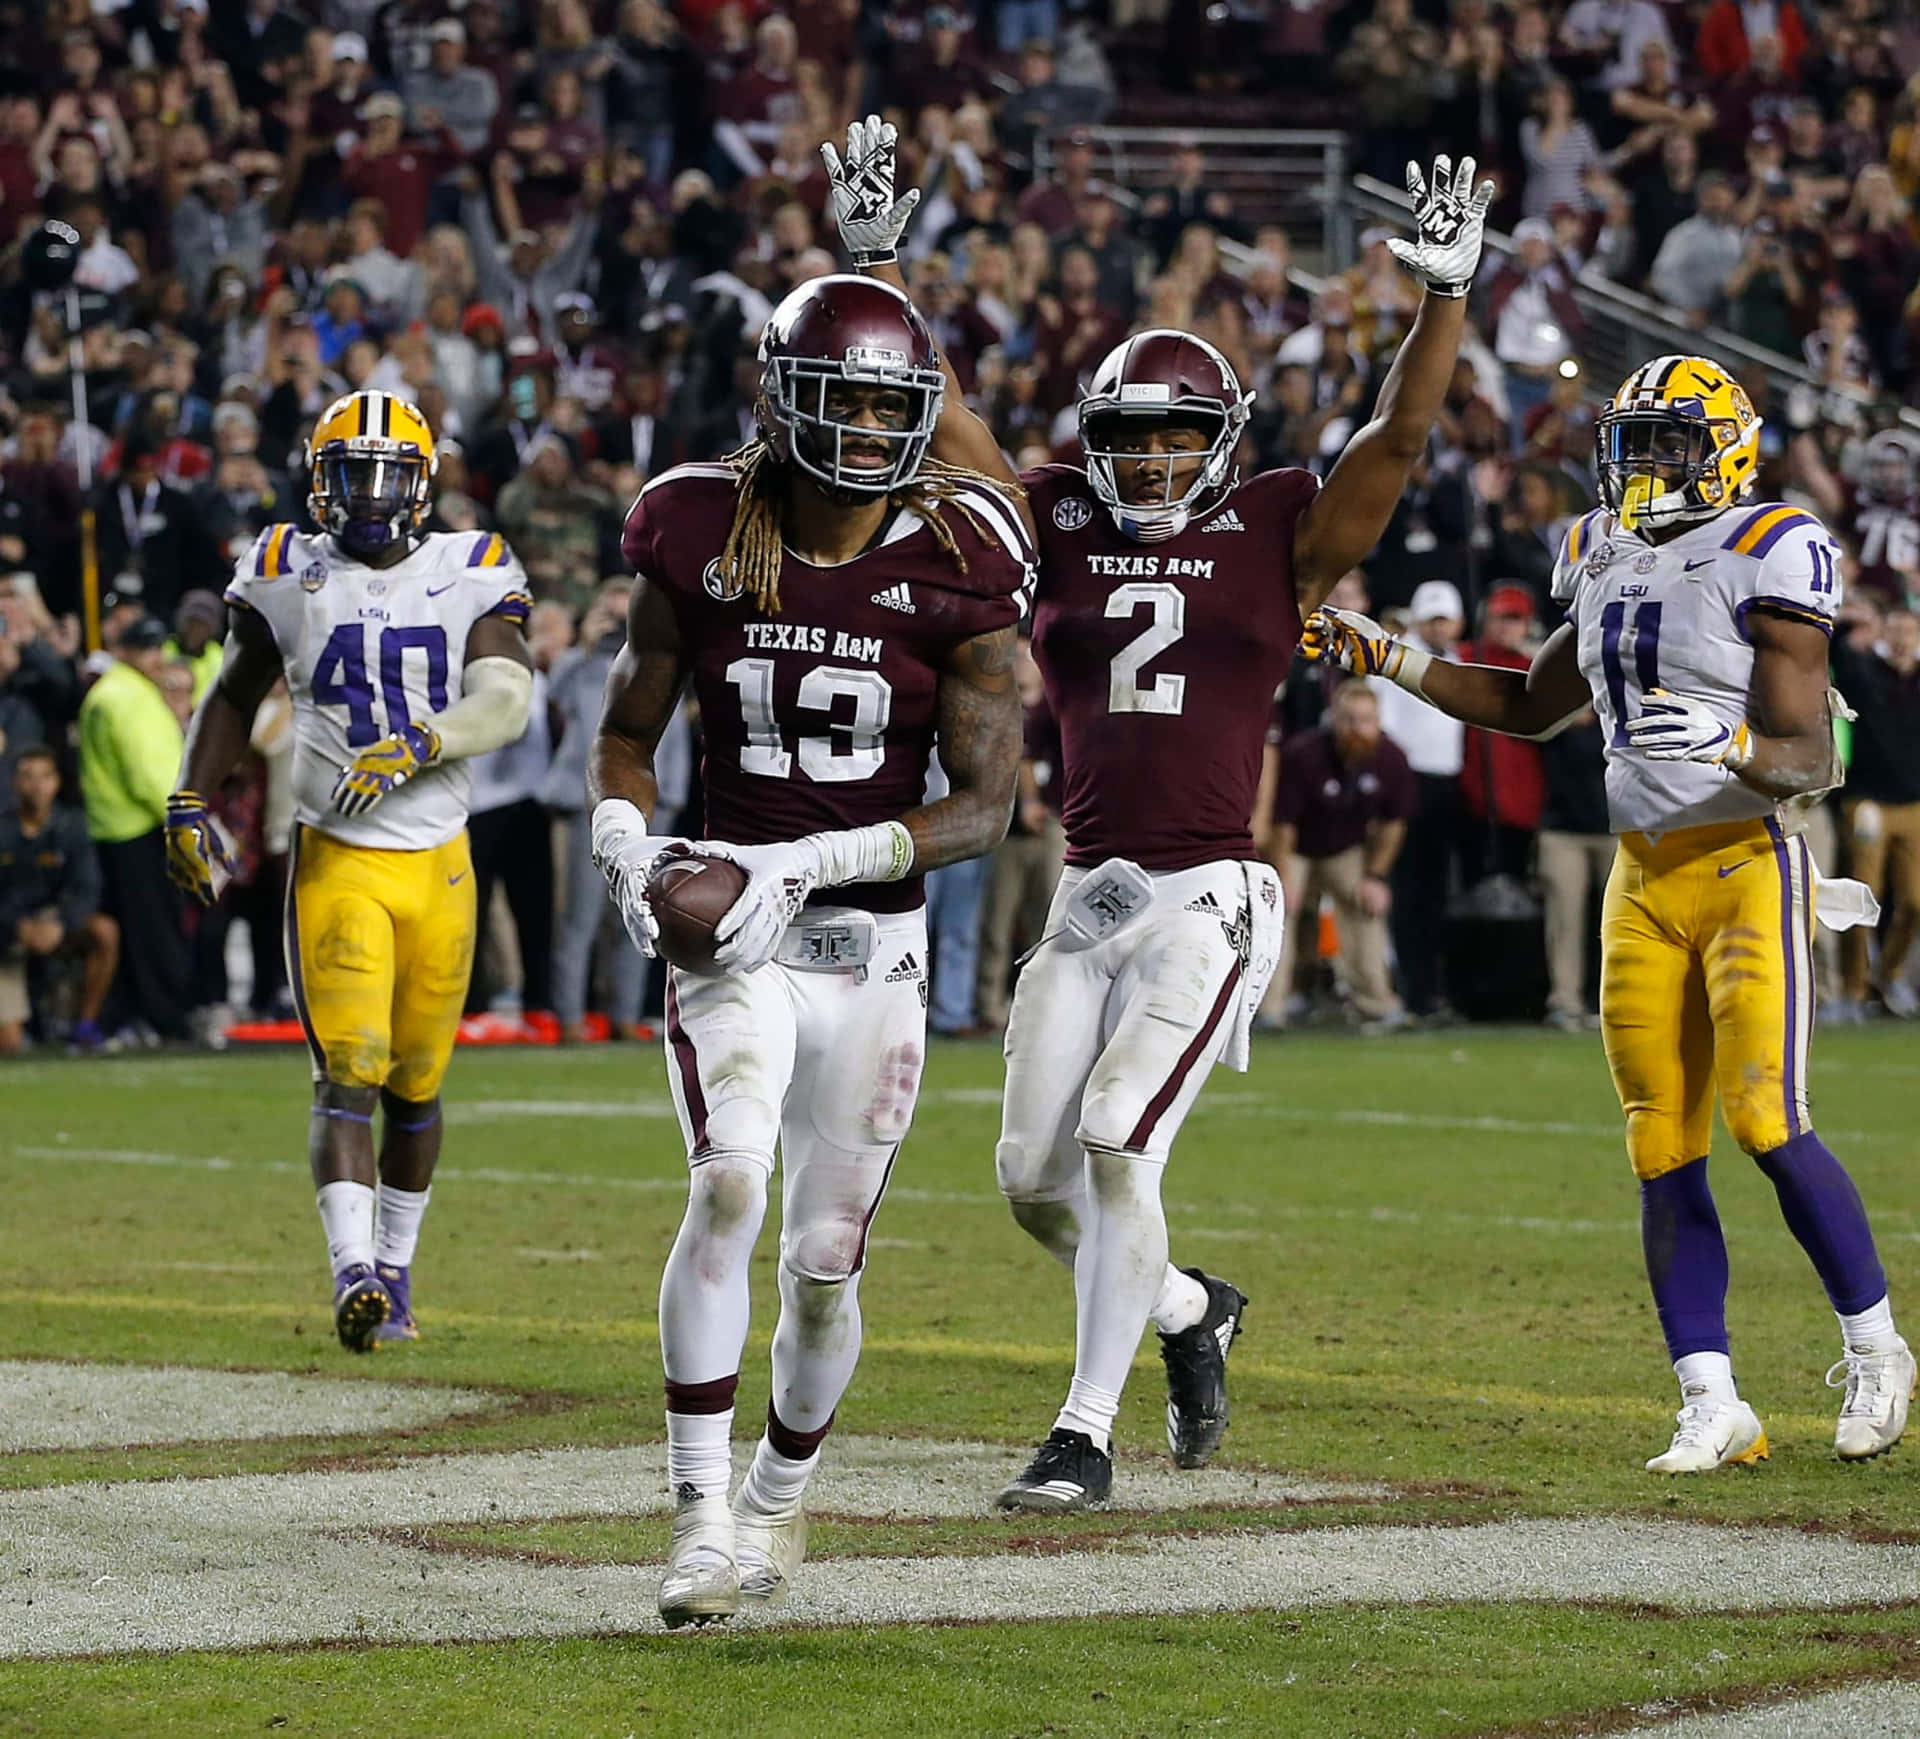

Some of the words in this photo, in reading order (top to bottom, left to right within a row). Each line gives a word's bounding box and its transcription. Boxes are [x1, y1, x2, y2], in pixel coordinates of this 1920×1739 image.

[1201, 521, 1246, 533] adidas
[1087, 555, 1159, 577] TEXAS
[1165, 557, 1215, 579] A&M
[1807, 540, 1833, 594] 11
[1620, 585, 1649, 598] LSU
[358, 608, 391, 623] LSU
[743, 623, 826, 653] TEXAS
[832, 631, 884, 663] A&M
[1104, 582, 1186, 716] 2
[311, 623, 449, 748] 40
[1600, 601, 1663, 748] 11
[725, 657, 892, 782] 13
[1183, 903, 1227, 919] adidas
